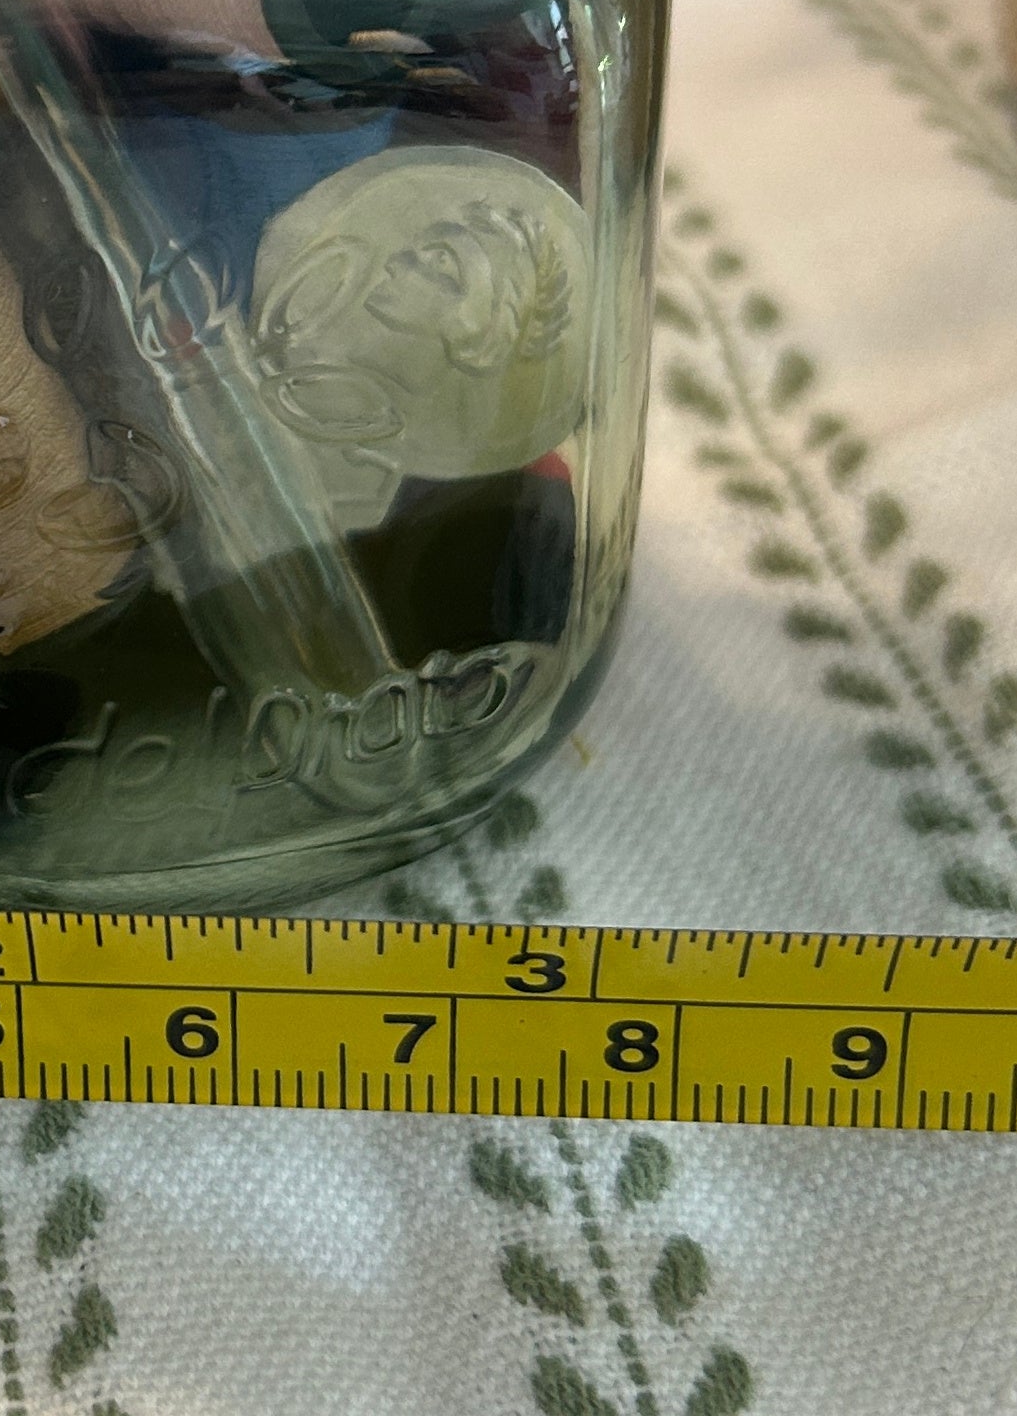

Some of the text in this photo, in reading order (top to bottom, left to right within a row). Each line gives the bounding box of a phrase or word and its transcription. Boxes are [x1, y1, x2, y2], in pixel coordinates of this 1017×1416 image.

[504, 951, 567, 994] 3
[165, 1006, 220, 1058] 6
[382, 1013, 437, 1063] 7
[603, 1019, 661, 1073] 8
[830, 1025, 888, 1079] 9
